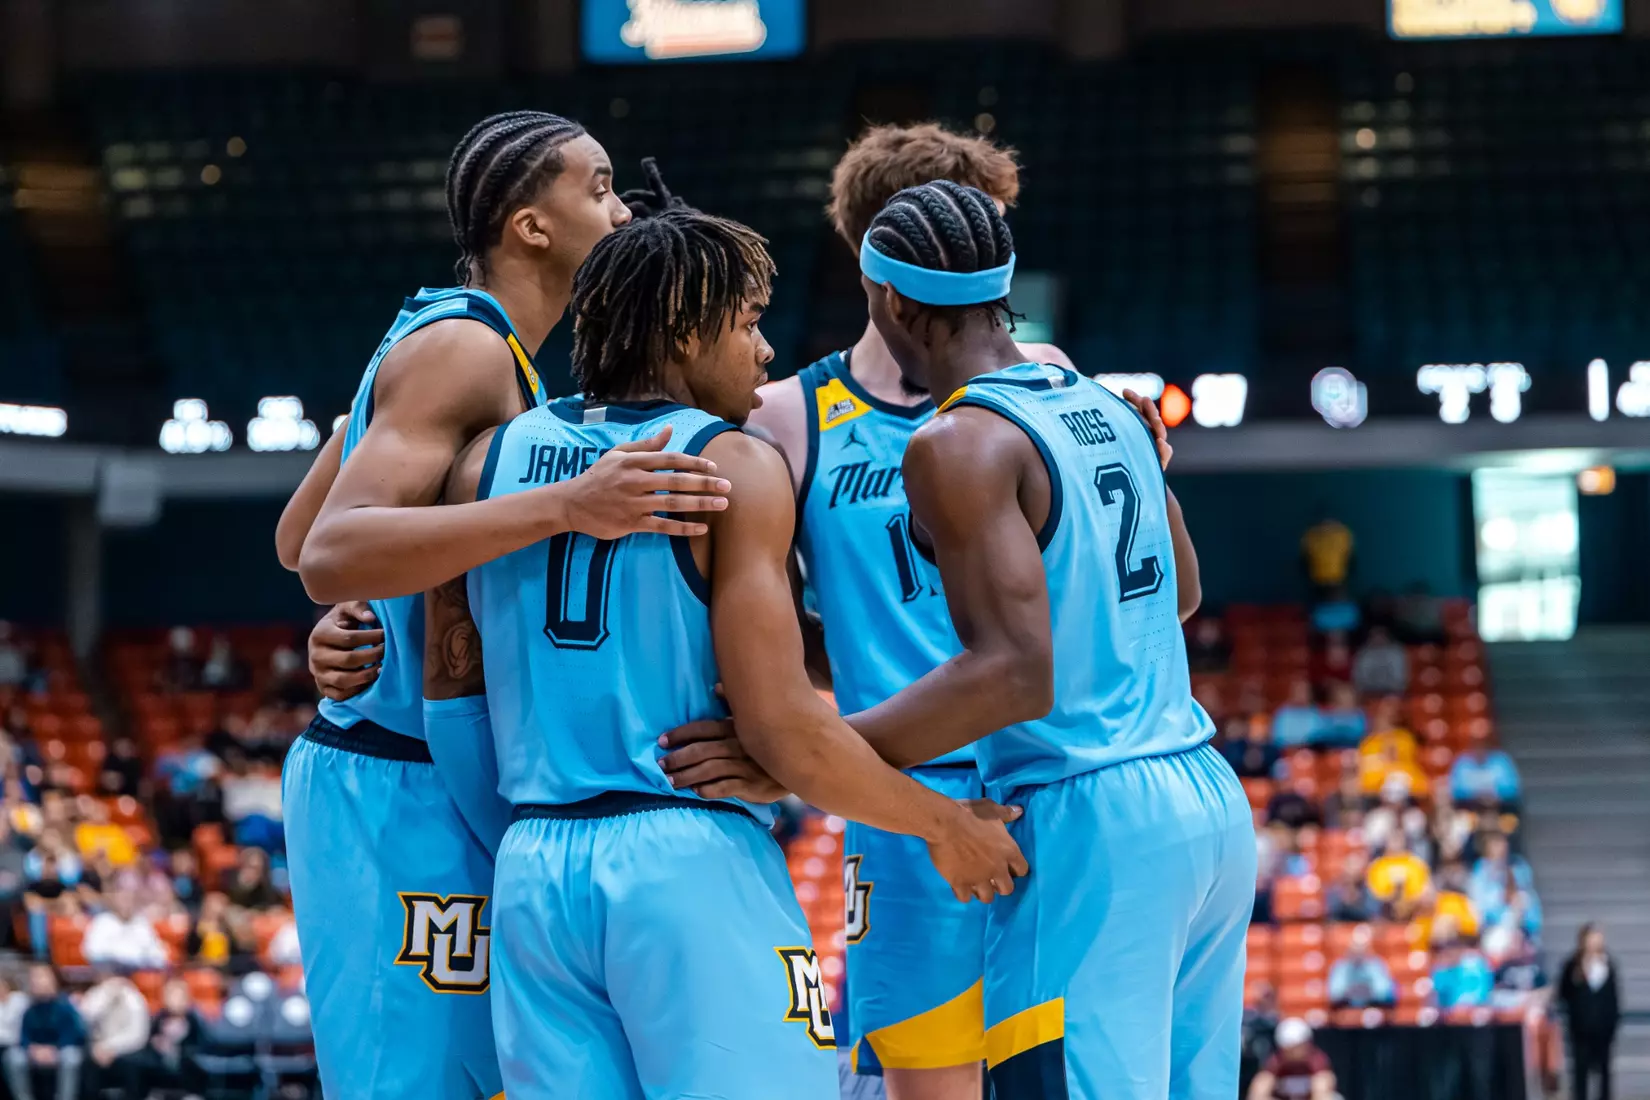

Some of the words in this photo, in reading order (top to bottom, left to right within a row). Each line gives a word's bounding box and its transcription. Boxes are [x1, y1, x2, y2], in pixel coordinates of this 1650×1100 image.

[1059, 408, 1116, 446] ROSS
[828, 460, 903, 509] Mar
[885, 513, 938, 604] 1
[1094, 462, 1164, 603] 2
[543, 531, 610, 651] 0
[396, 893, 490, 993] MU
